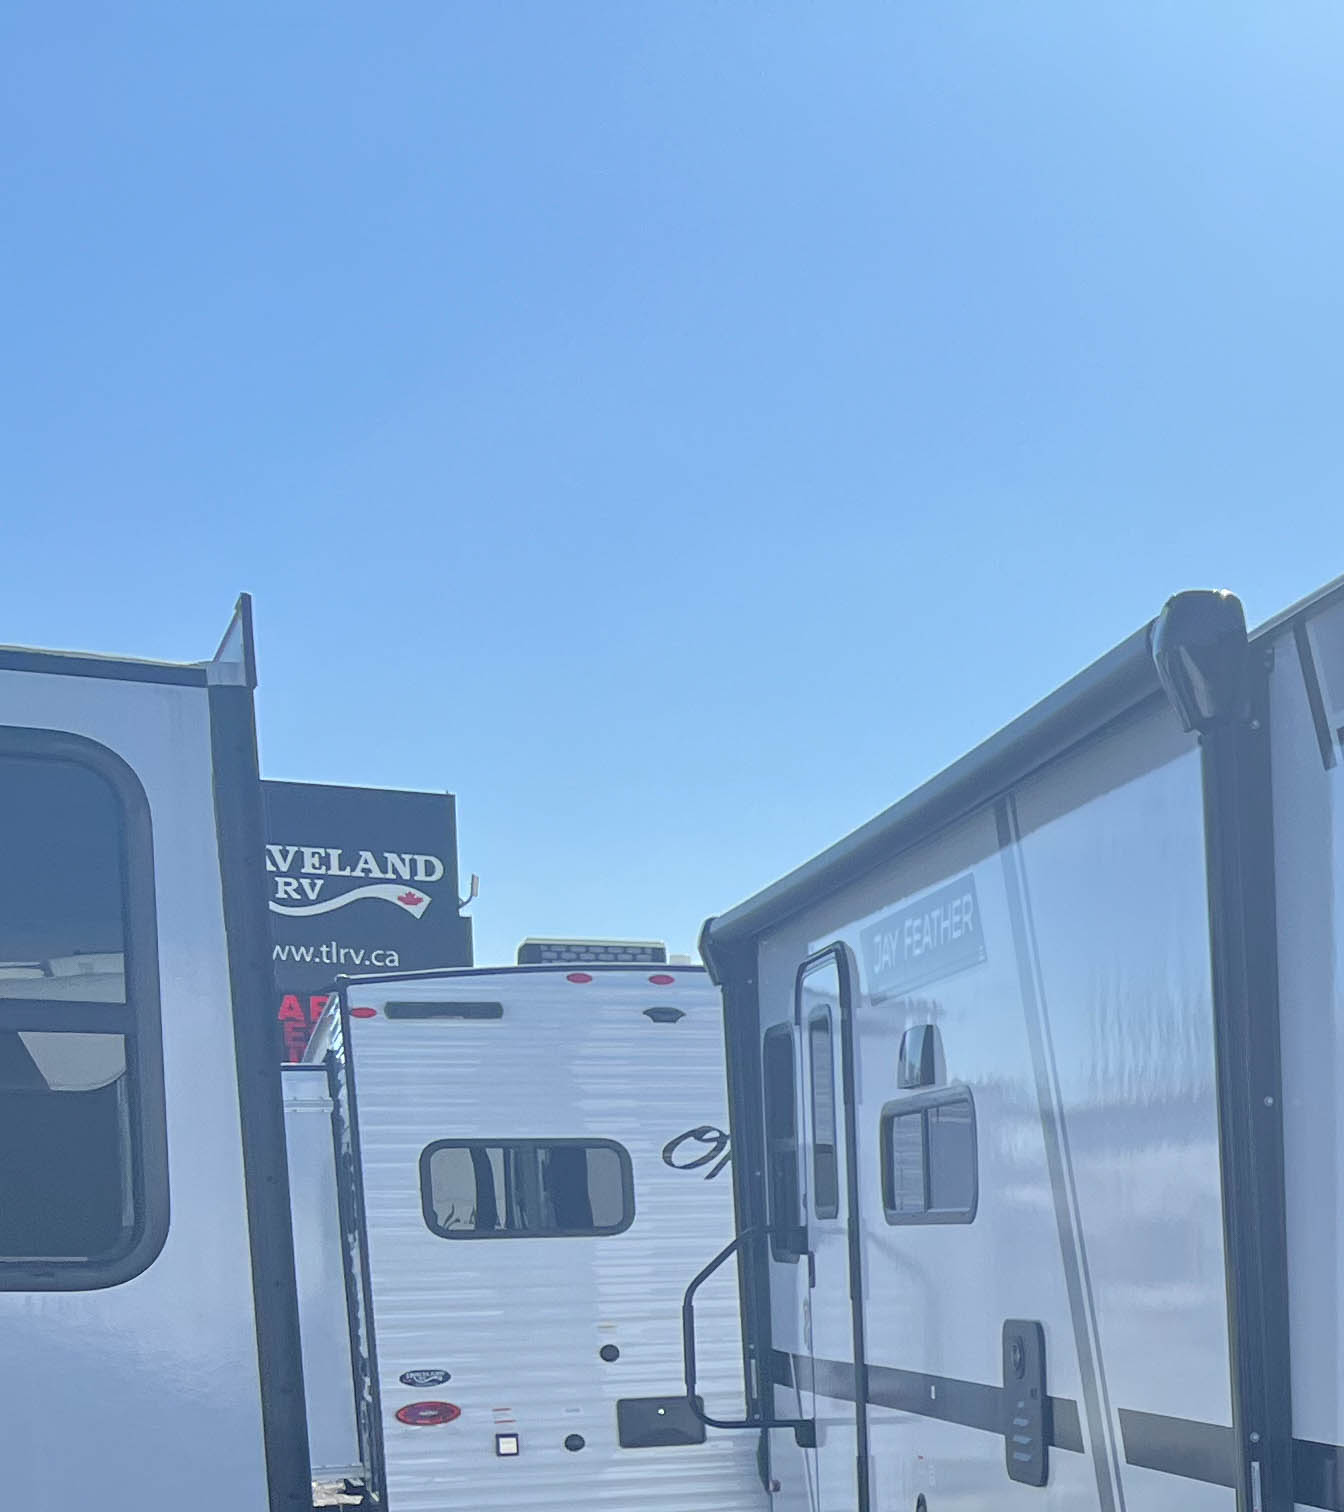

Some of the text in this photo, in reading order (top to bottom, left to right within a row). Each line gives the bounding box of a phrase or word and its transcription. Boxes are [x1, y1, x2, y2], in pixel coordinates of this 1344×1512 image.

[274, 876, 324, 900] RV
[873, 893, 974, 974] JAY FEATHER
